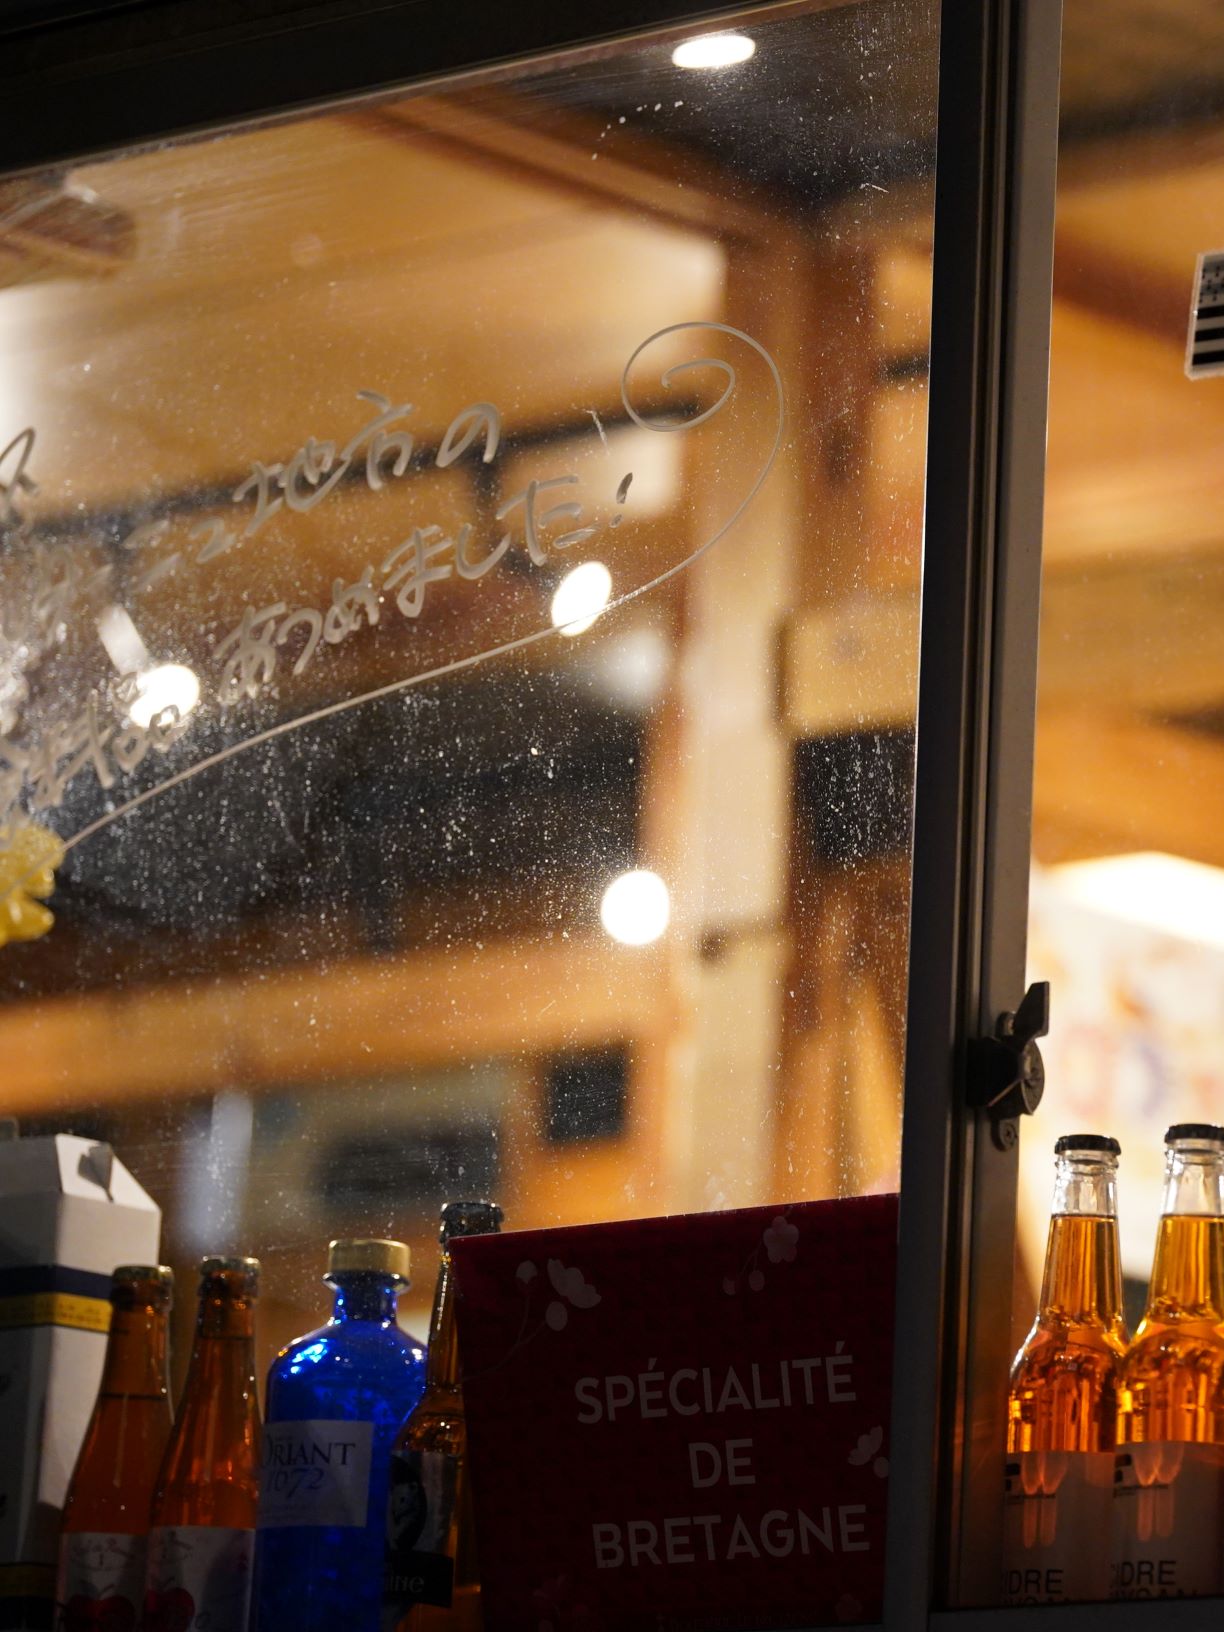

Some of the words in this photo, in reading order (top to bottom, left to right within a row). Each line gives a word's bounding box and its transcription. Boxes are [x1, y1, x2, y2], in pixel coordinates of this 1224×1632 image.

[574, 1340, 857, 1425] SPÉCIALITÉ
[688, 1438, 756, 1489] DE
[591, 1503, 871, 1569] BRETAGNE
